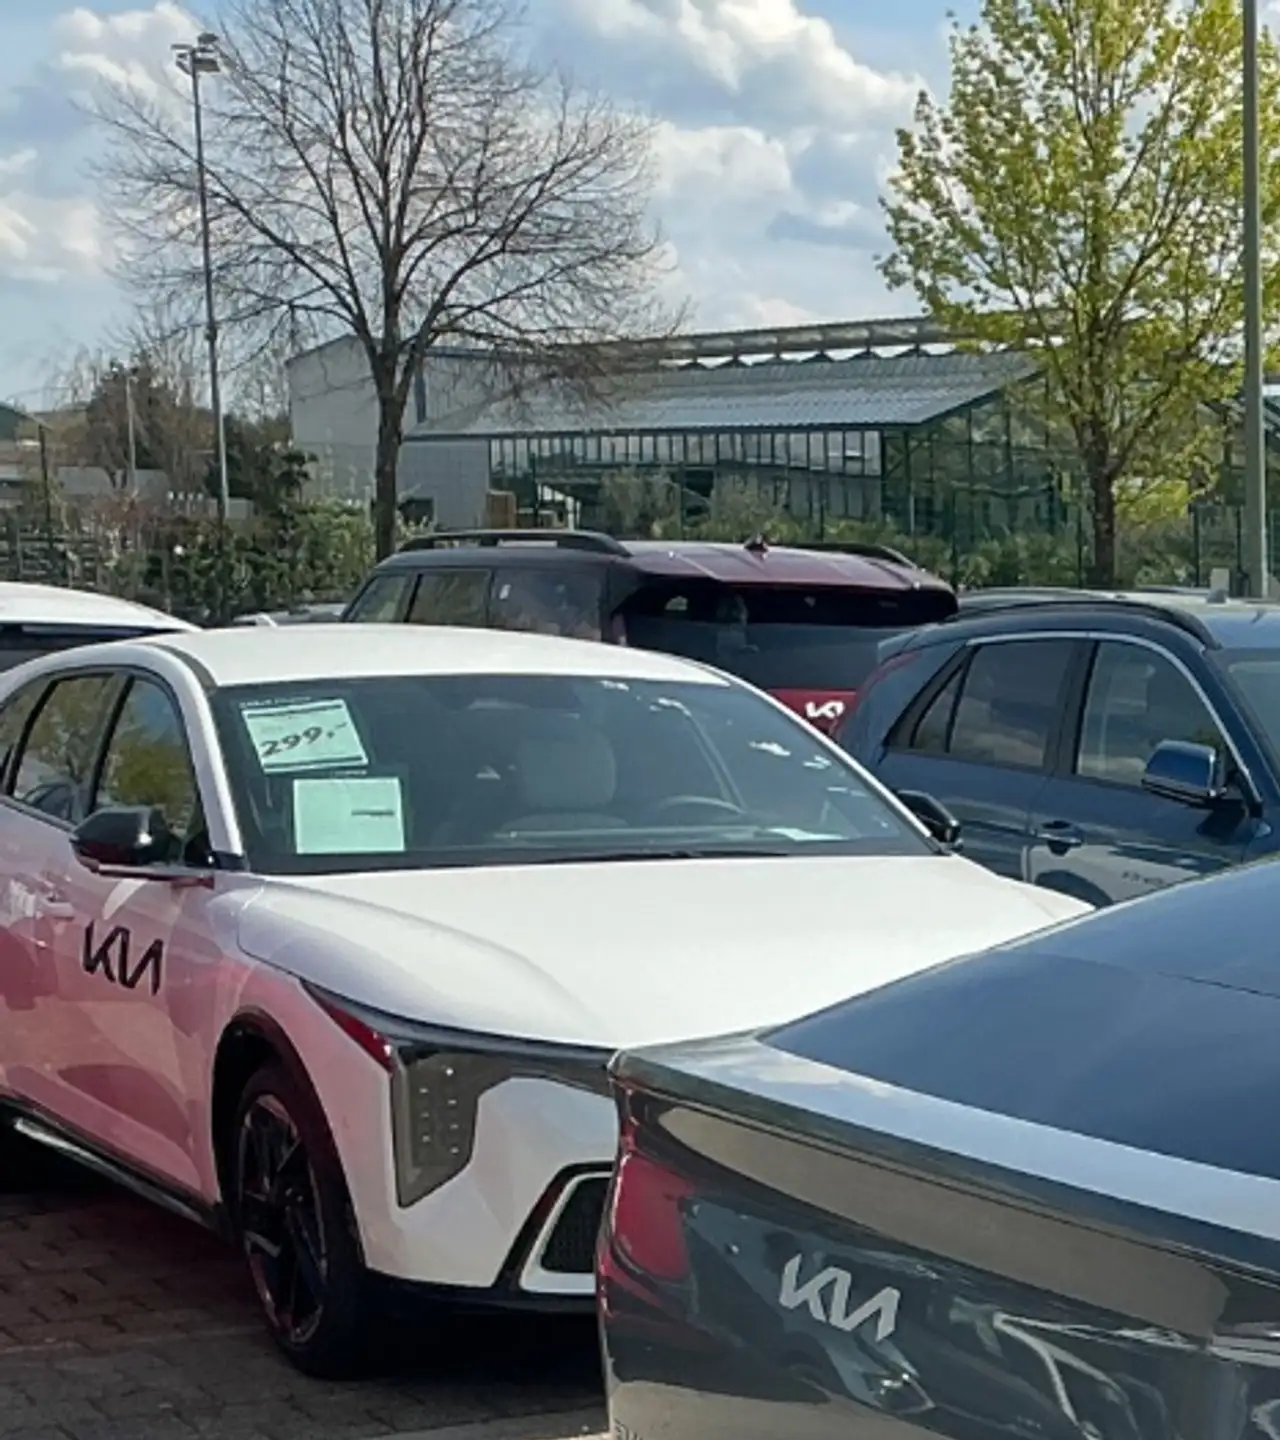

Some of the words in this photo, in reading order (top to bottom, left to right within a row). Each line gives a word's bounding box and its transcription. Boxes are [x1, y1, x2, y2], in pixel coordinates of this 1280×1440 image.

[804, 700, 845, 719] KI
[82, 919, 165, 997] KIA
[778, 1253, 901, 1343] KIA
